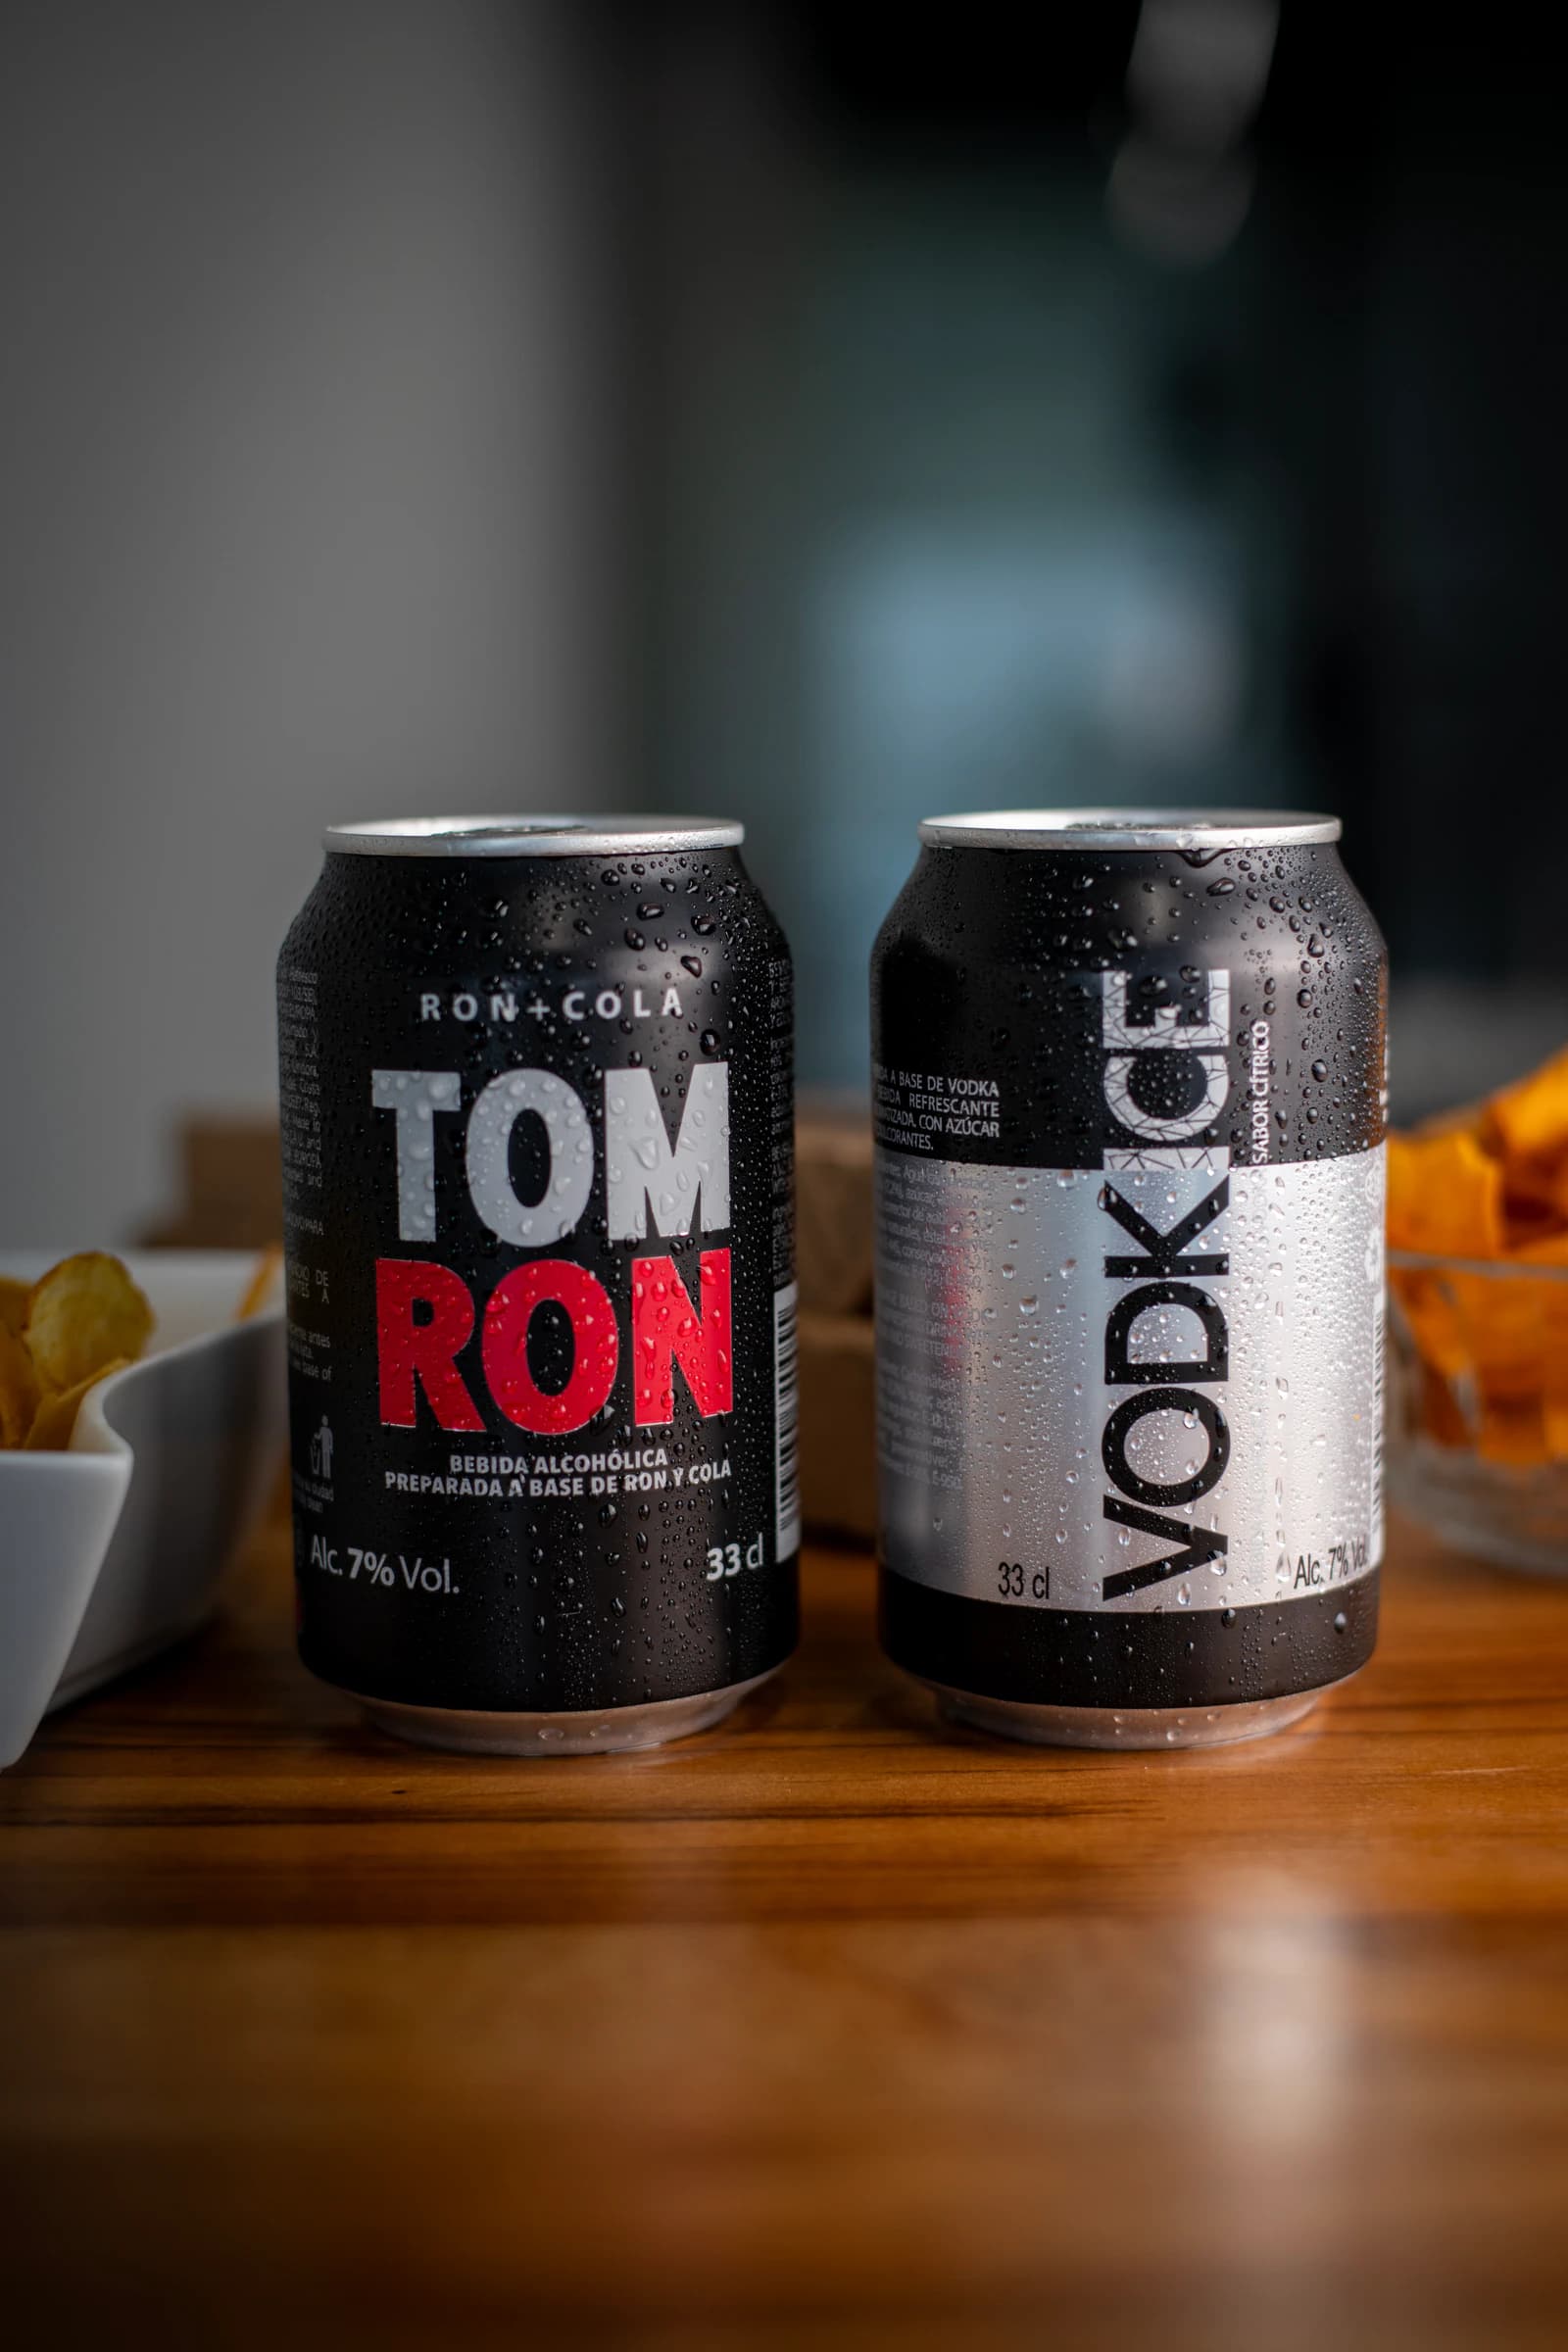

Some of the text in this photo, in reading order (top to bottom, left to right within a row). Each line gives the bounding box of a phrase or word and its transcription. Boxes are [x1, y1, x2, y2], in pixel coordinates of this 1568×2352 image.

[899, 1071, 923, 1090] BASE
[927, 1075, 945, 1093] DE
[948, 1077, 1000, 1098] VODKA
[1250, 1020, 1270, 1164] SABOR CÍTRICO
[909, 1093, 1000, 1117] REFRESCANTE
[918, 1114, 942, 1132] CON
[946, 1116, 1000, 1138] AZÚCAR
[370, 1060, 731, 1248] TOM
[375, 1247, 733, 1436] RON
[385, 1459, 732, 1497] PREPARADA A BASE DE RON Y COLA
[450, 1448, 668, 1474] BEBIDA ALCOHÓLICA
[311, 1534, 460, 1593] Alc. 7% Vol.
[707, 1543, 741, 1581] 33
[998, 1562, 1050, 1599] 33 cl
[1294, 1552, 1325, 1590] Alc.
[1328, 1542, 1348, 1580] 7%
